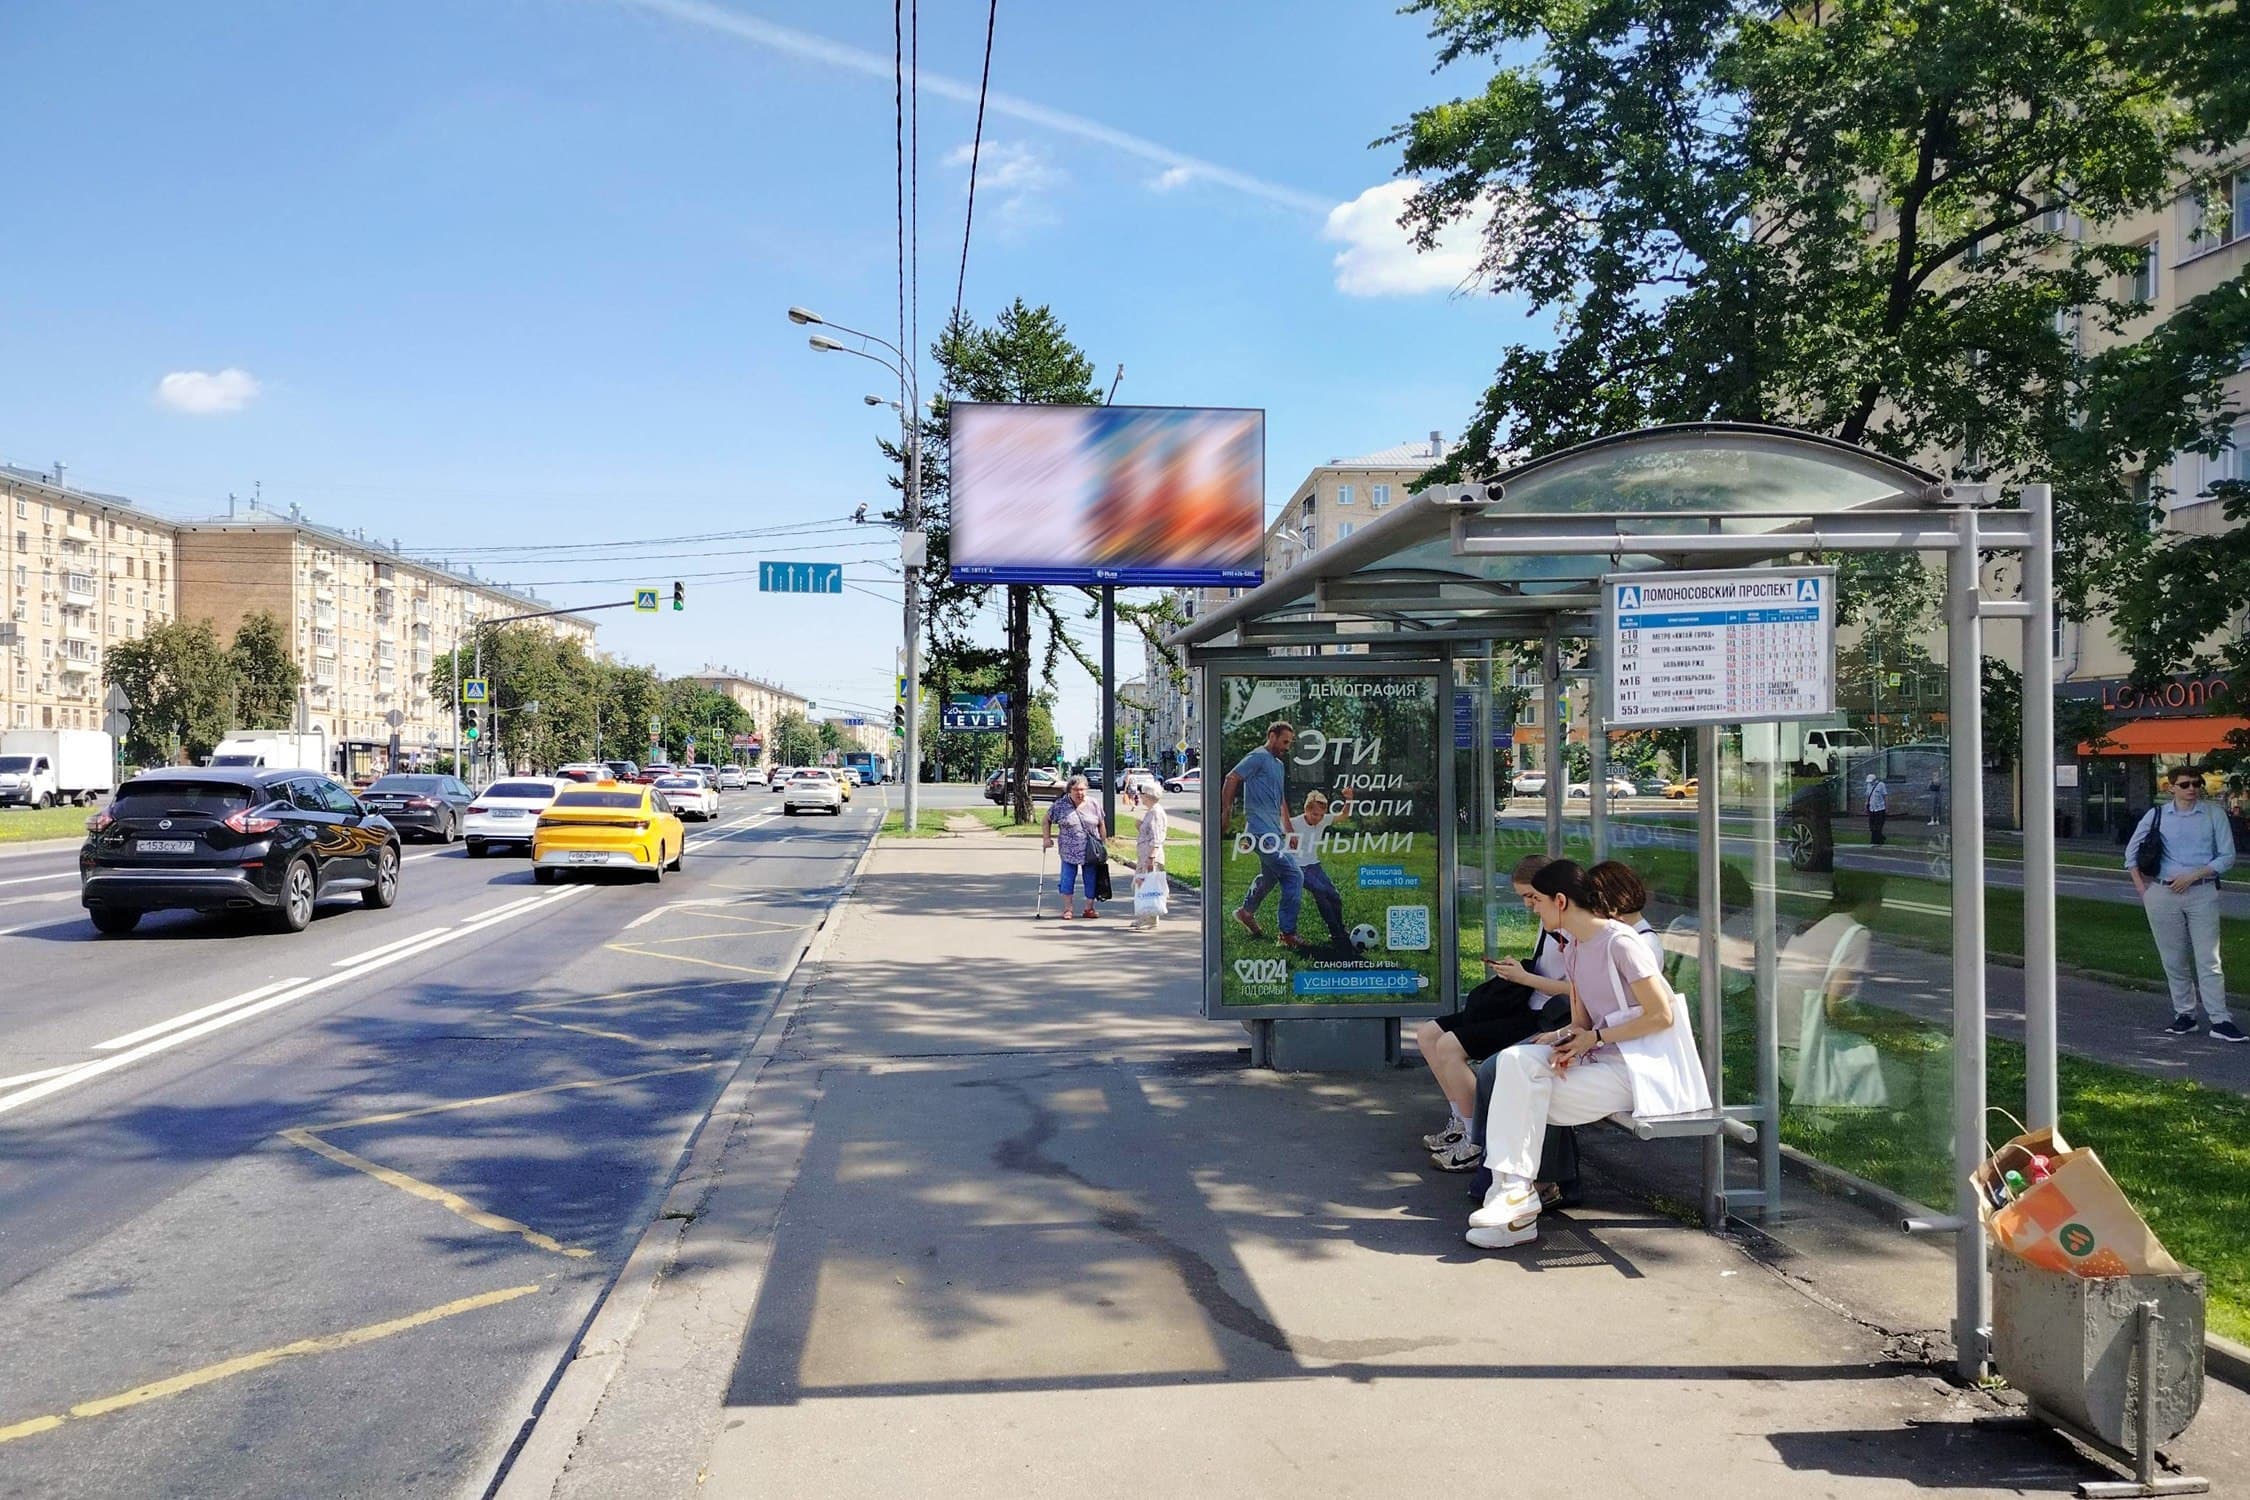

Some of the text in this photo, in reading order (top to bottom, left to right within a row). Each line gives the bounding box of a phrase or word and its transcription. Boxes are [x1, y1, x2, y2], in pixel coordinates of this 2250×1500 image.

[1642, 583, 1736, 602] ЛОМОНОСОВСКИЙ
[1739, 583, 1792, 597] ПРОСПЕКТ
[1309, 683, 1416, 700] ДЕМОГРАФИЯ
[1621, 706, 1638, 715] 553
[944, 715, 1007, 726] LEVEL
[1294, 730, 1382, 765] Эти
[1333, 773, 1403, 792] люди
[1328, 800, 1413, 816] стали
[1232, 831, 1414, 861] родными
[1314, 961, 1375, 970] СТАНОВИТЕСЬ
[1385, 960, 1398, 969] ВЫ
[1303, 974, 1409, 989] усыновите.рф
[1241, 984, 1256, 996] ГОД
